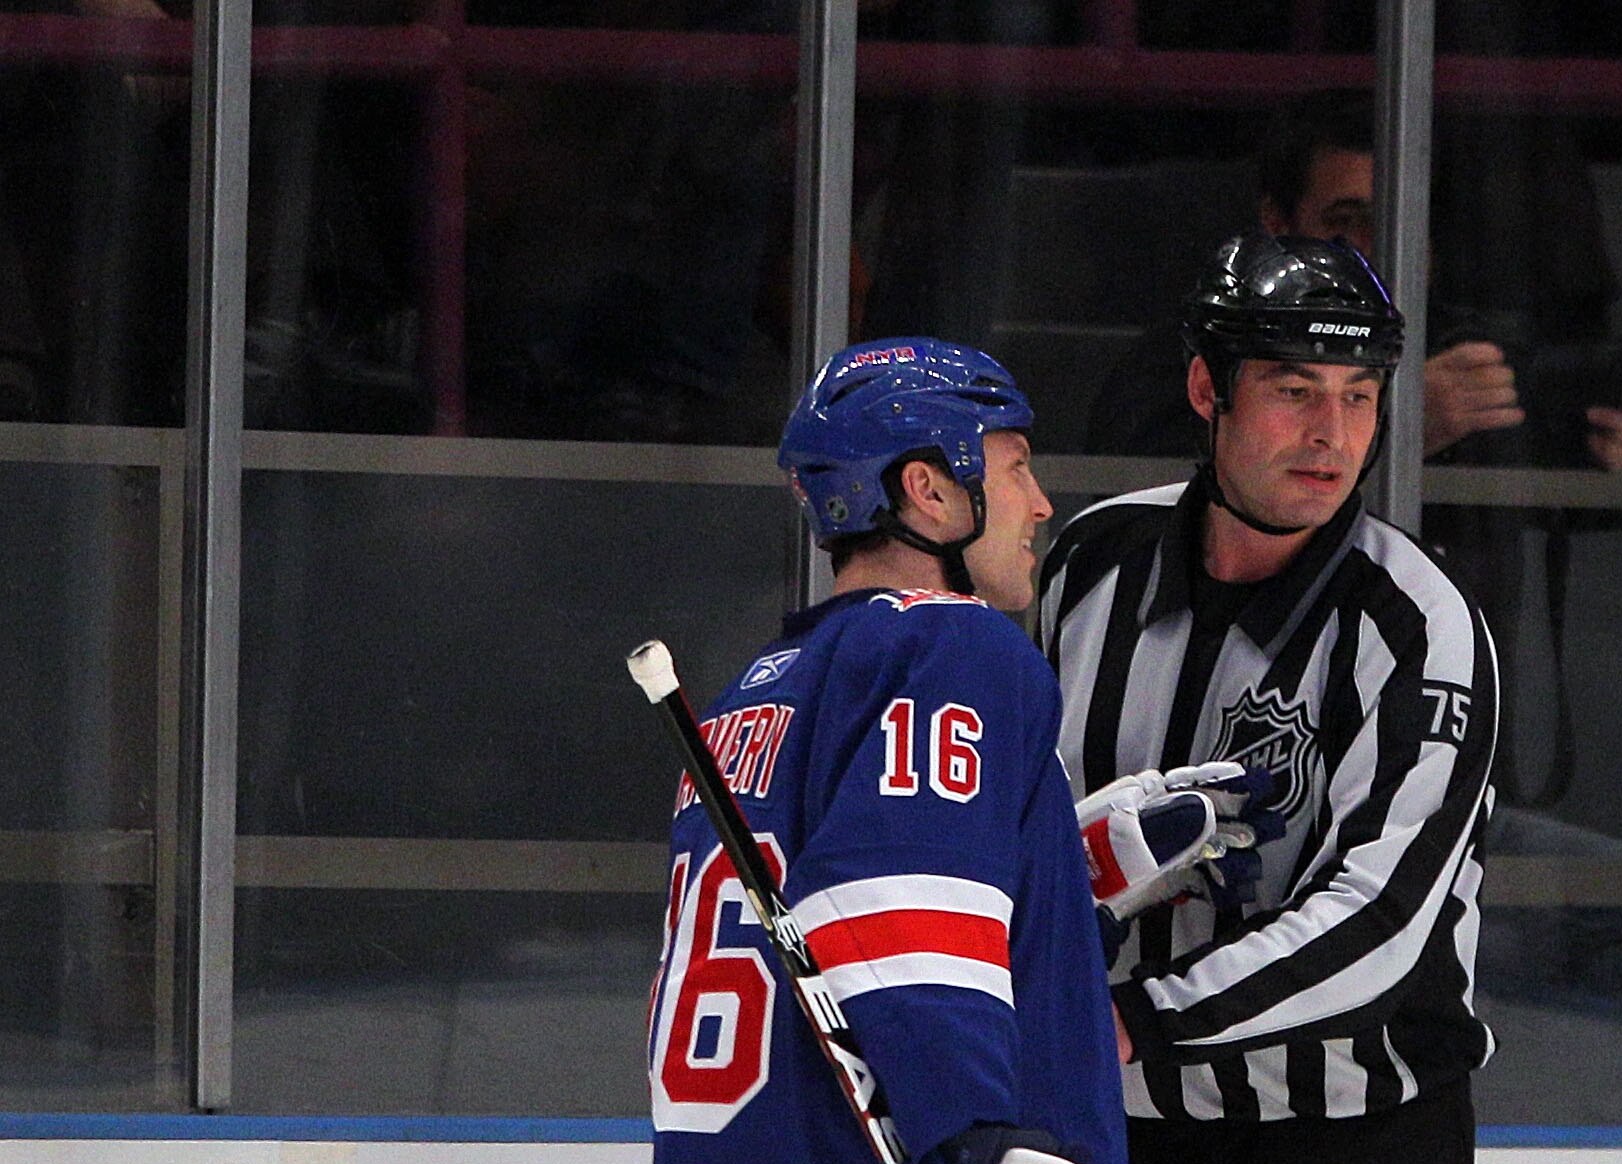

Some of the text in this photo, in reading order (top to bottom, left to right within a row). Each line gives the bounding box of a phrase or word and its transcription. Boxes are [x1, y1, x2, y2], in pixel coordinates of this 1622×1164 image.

[1308, 322, 1371, 338] BAUER
[1421, 687, 1472, 742] 75
[879, 698, 983, 803] 16
